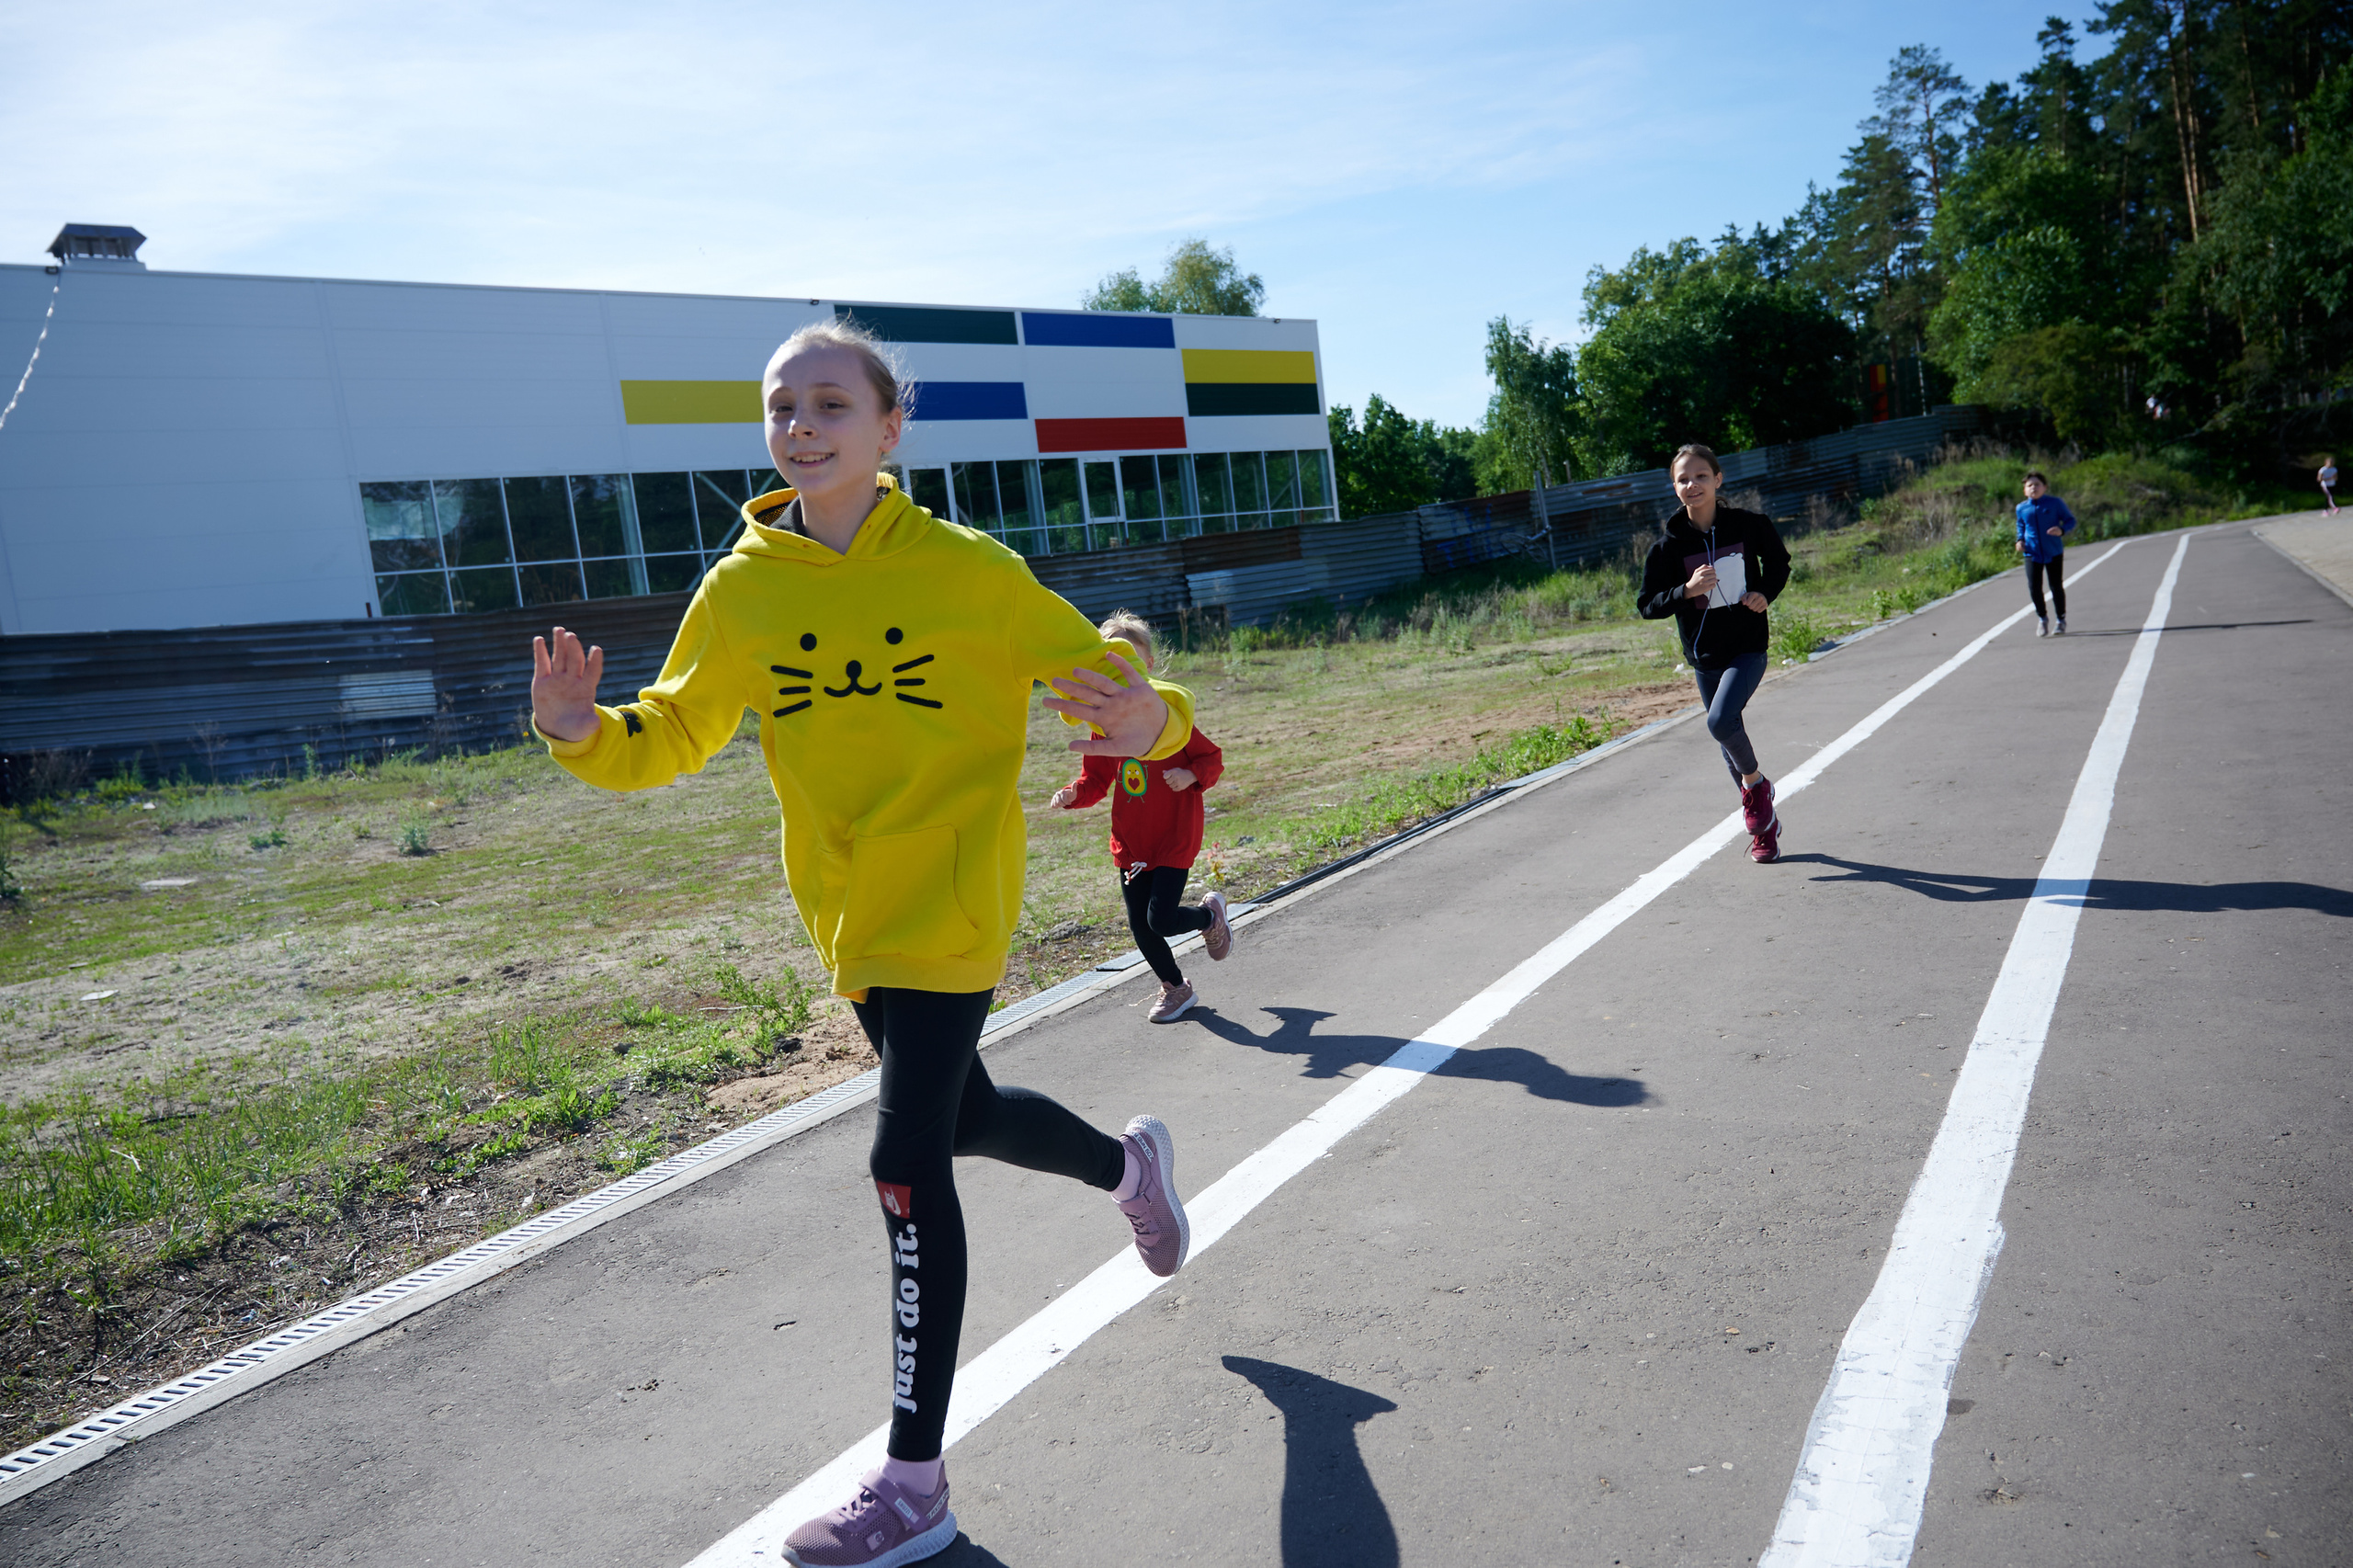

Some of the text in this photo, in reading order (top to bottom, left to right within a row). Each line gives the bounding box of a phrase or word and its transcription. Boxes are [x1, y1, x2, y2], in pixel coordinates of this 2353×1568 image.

[892, 1222, 920, 1414] just do it.
